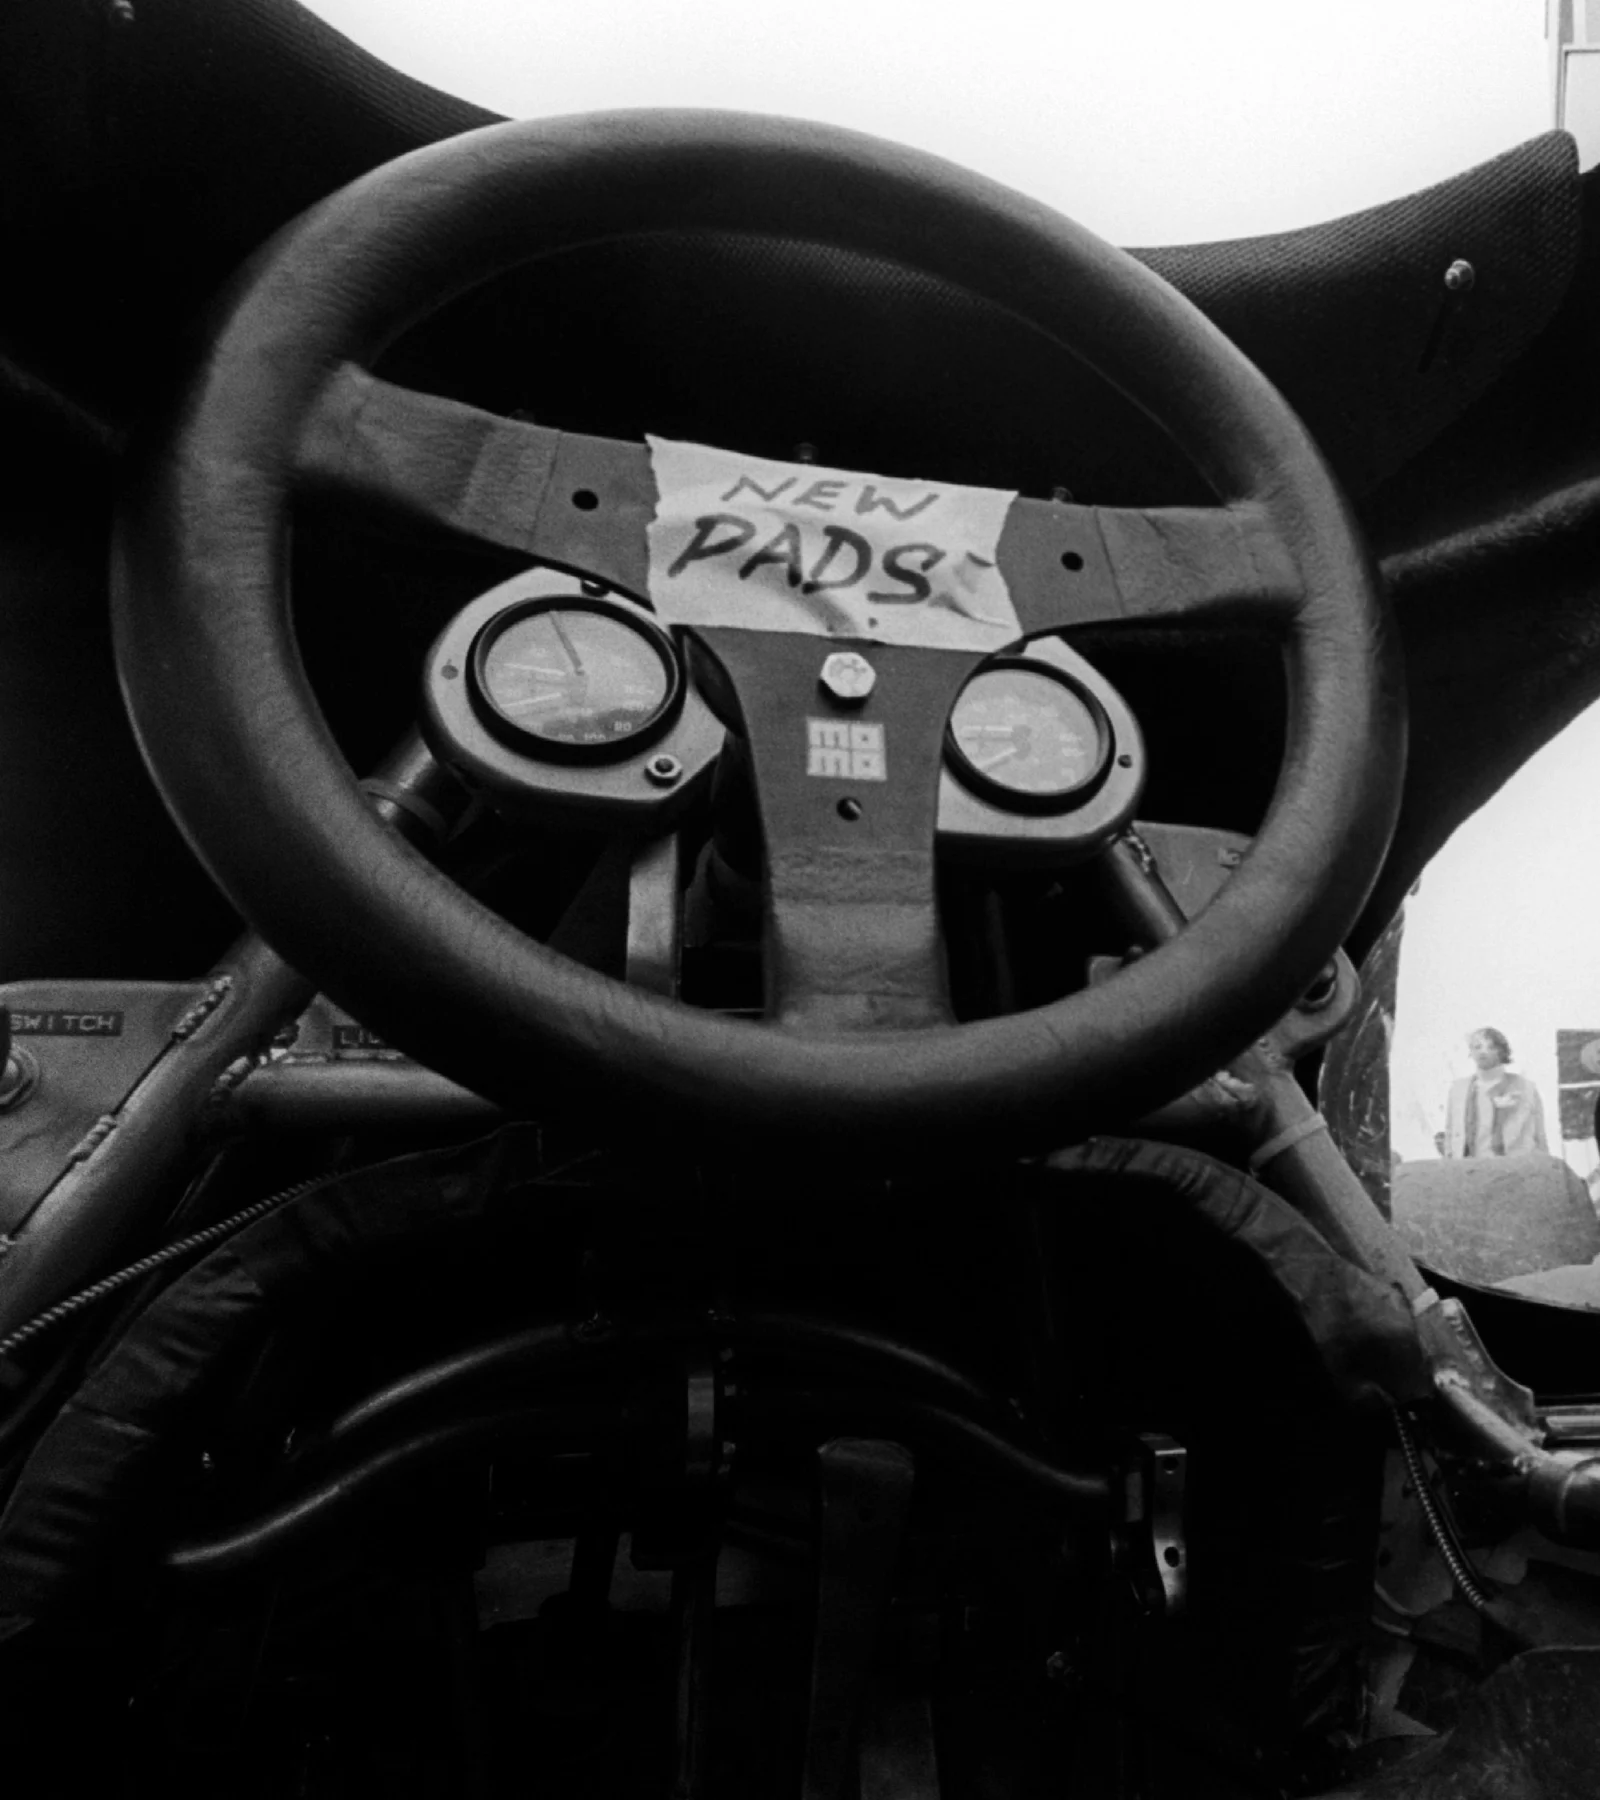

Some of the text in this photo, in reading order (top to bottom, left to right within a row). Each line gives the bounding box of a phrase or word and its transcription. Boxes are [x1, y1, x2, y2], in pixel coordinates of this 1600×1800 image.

[721, 474, 940, 521] NEW
[667, 513, 947, 605] PADS
[9, 1013, 115, 1032] SWITCH
